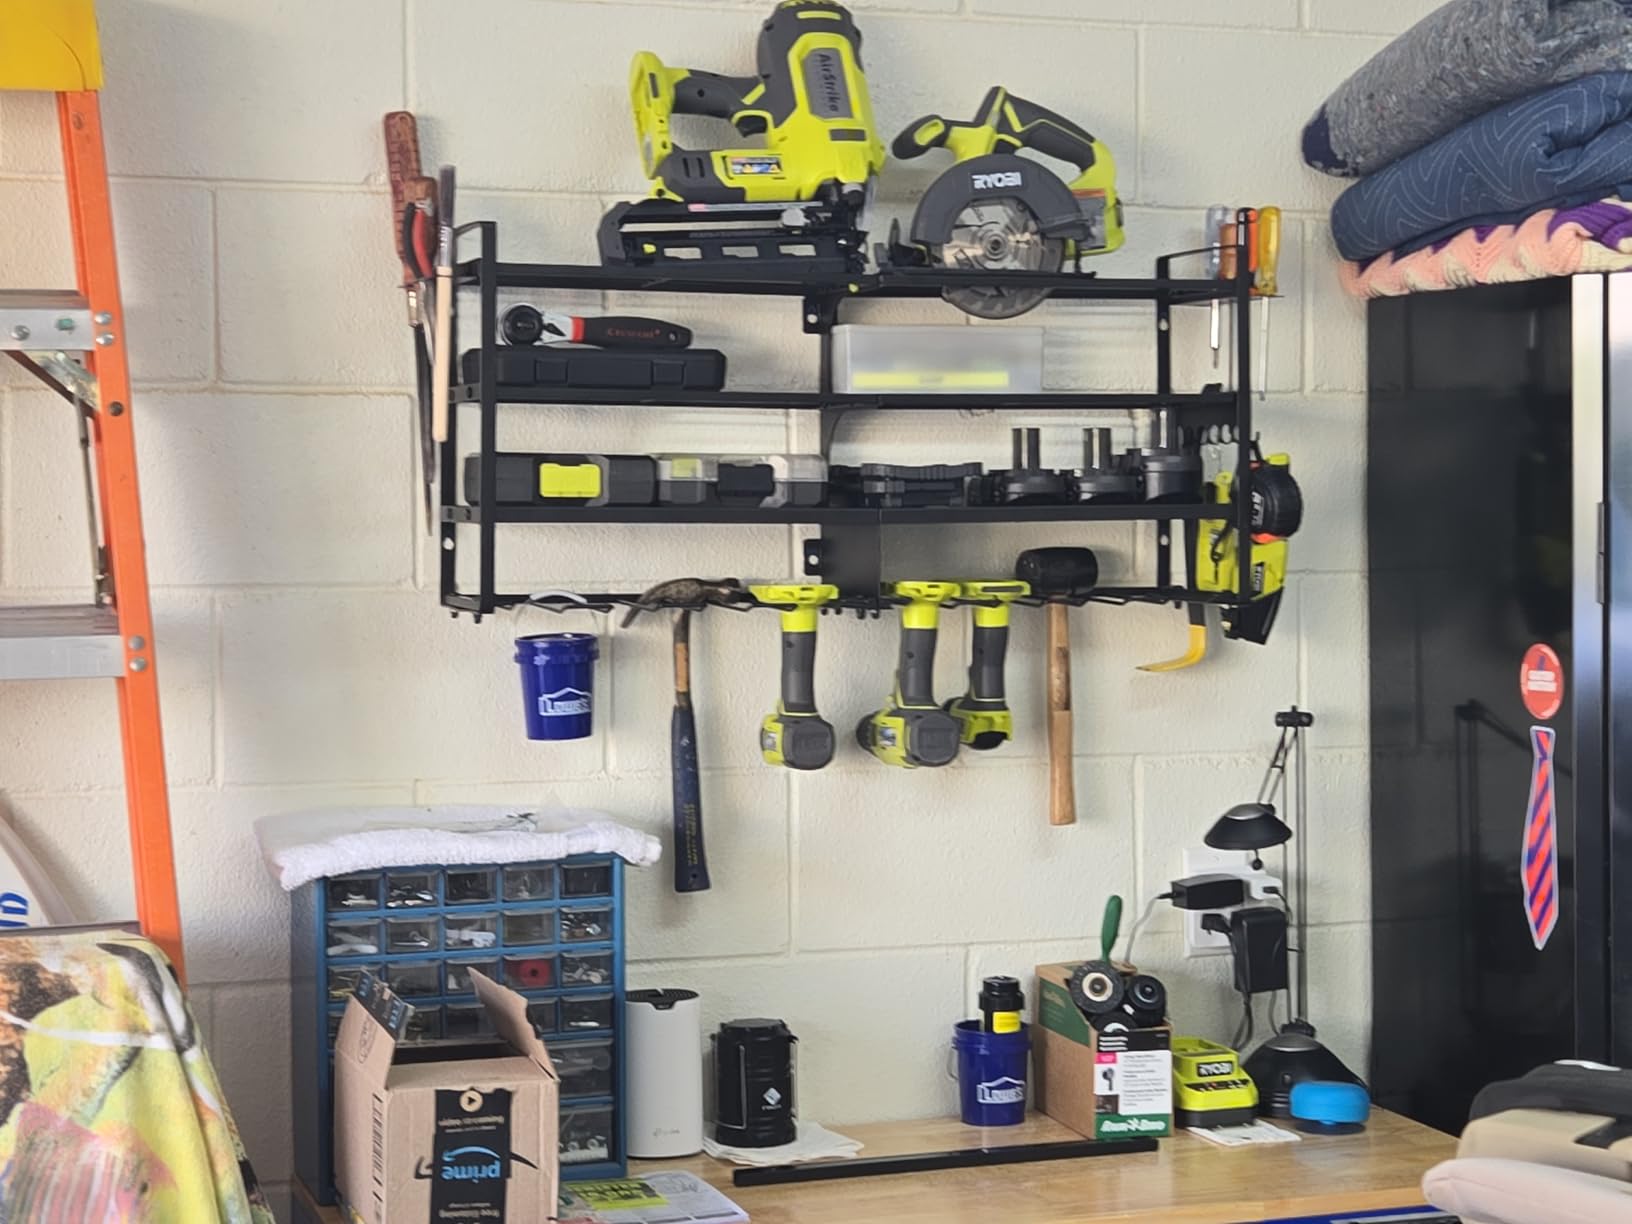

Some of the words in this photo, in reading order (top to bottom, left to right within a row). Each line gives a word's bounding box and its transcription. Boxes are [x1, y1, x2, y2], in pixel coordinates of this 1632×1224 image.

[817, 53, 841, 112] AirStrike
[971, 171, 1022, 189] RYOBI
[1199, 1062, 1232, 1076] RYOBI
[441, 1160, 501, 1183] prime
